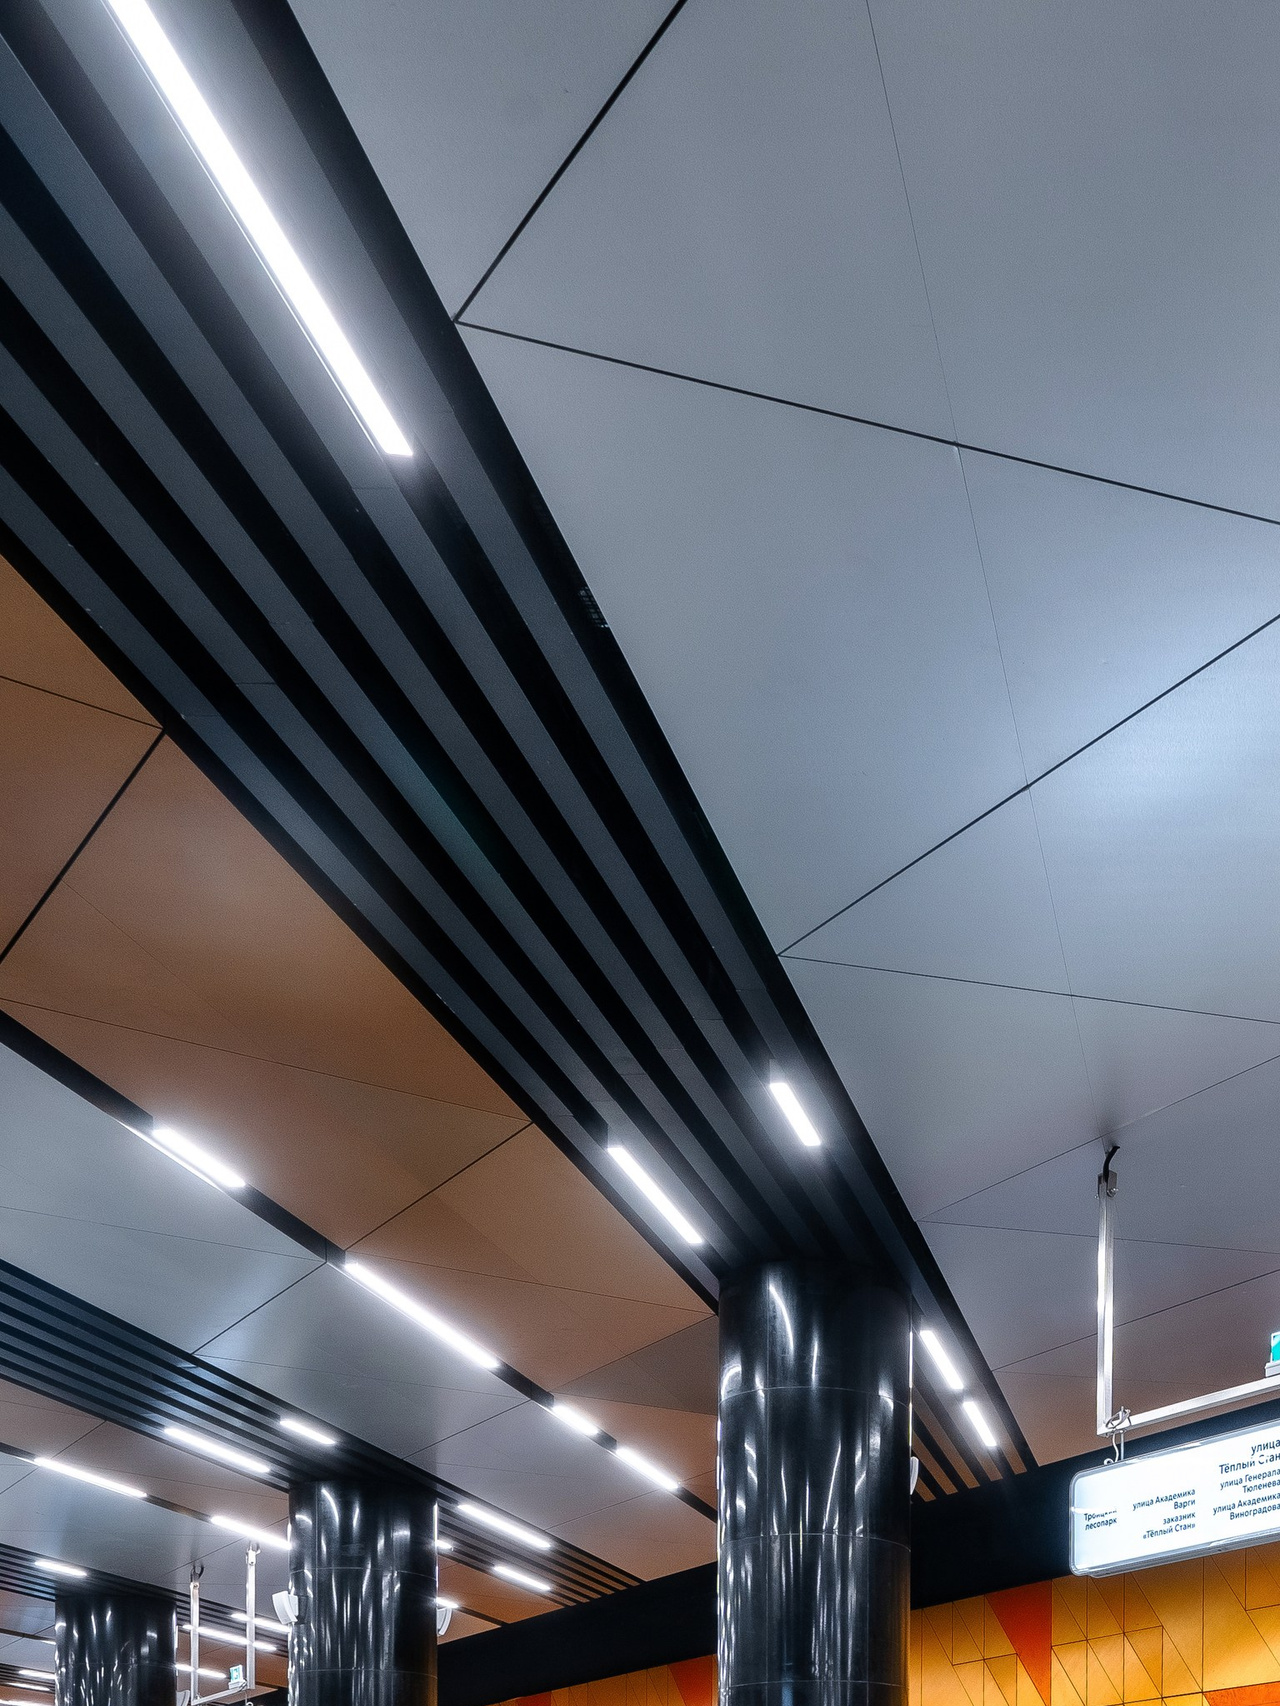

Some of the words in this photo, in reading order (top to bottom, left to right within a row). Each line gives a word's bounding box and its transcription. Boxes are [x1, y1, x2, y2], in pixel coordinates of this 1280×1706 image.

[1251, 1439, 1280, 1457] улица
[1220, 1477, 1243, 1491] улица
[1244, 1468, 1280, 1484] Генерала
[1242, 1479, 1280, 1494] Тюленева
[1132, 1499, 1154, 1512] улица
[1155, 1489, 1196, 1505] Академика
[1173, 1499, 1196, 1510] Варги
[1212, 1502, 1236, 1516] улица
[1237, 1493, 1280, 1508] Академика
[1163, 1512, 1196, 1526] заказник
[1230, 1503, 1280, 1520] Виноградова
[1085, 1517, 1118, 1531] лесопарк
